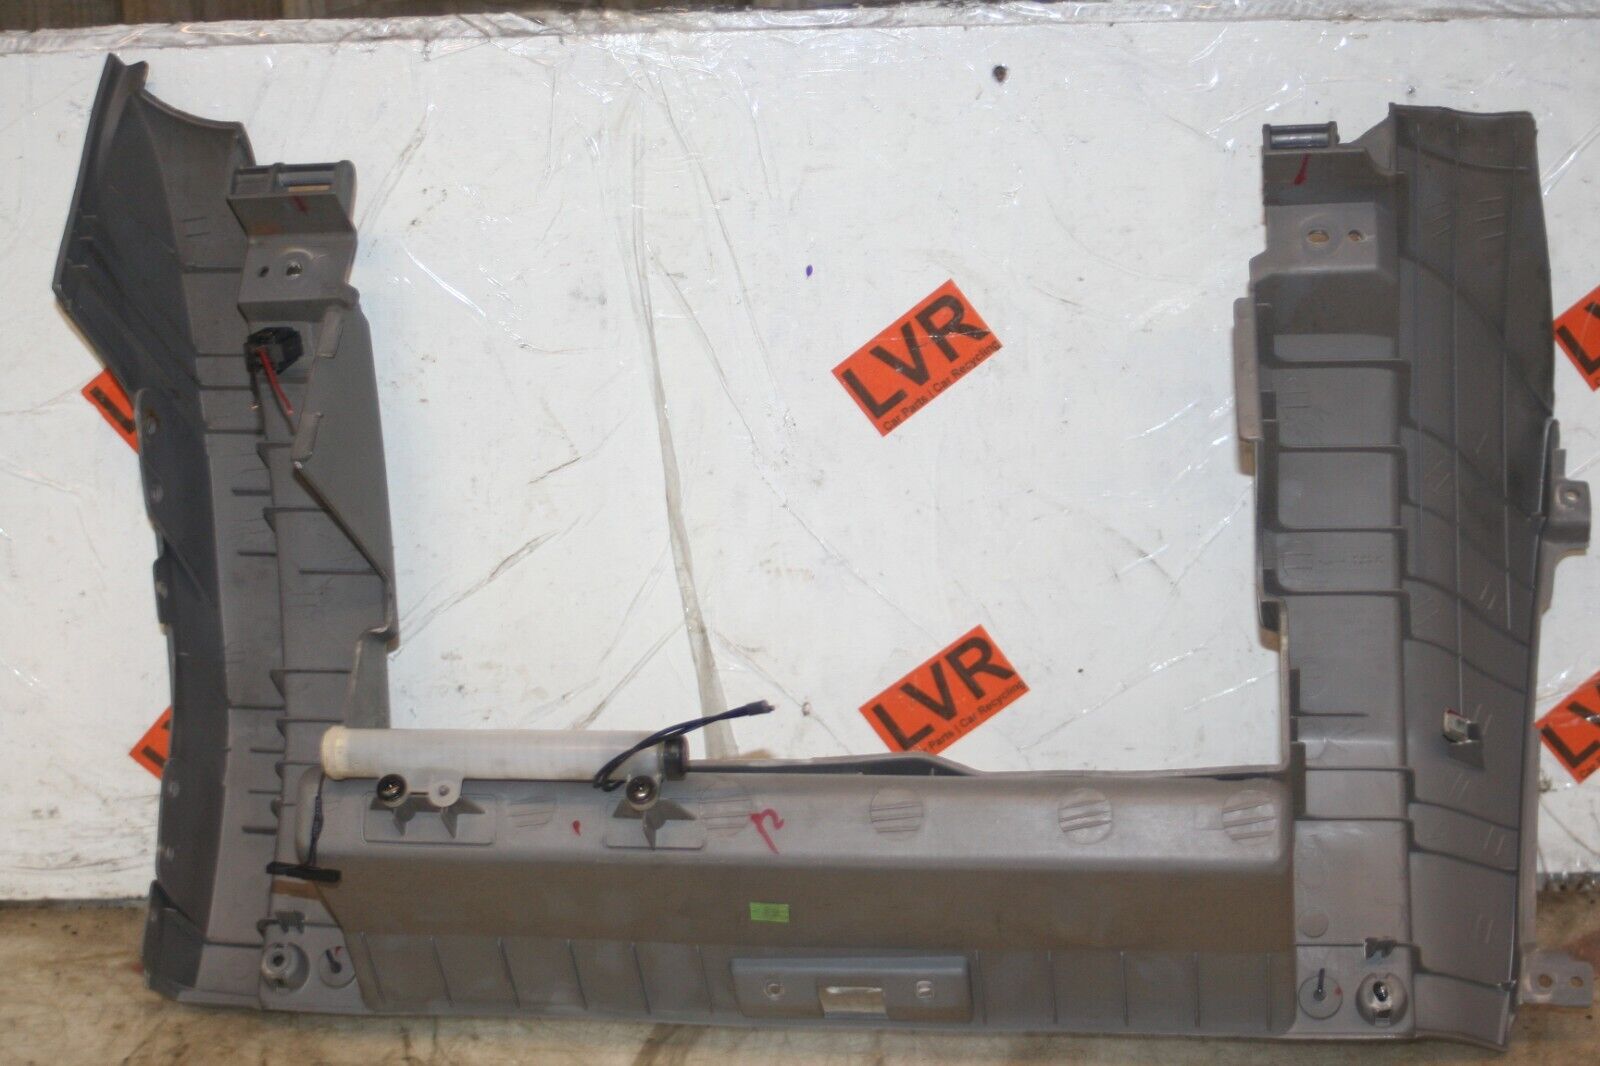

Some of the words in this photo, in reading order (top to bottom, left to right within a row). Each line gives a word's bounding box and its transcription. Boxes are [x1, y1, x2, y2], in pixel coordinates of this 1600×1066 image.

[842, 294, 992, 419] LVR
[883, 415, 901, 431] Car
[901, 395, 928, 417] Parts
[933, 377, 951, 393] Car
[951, 342, 1001, 376] Recycling
[873, 636, 1016, 751] LVR
[928, 731, 954, 750] Parts
[960, 713, 977, 728] Car
[977, 680, 1027, 713] Recycling
